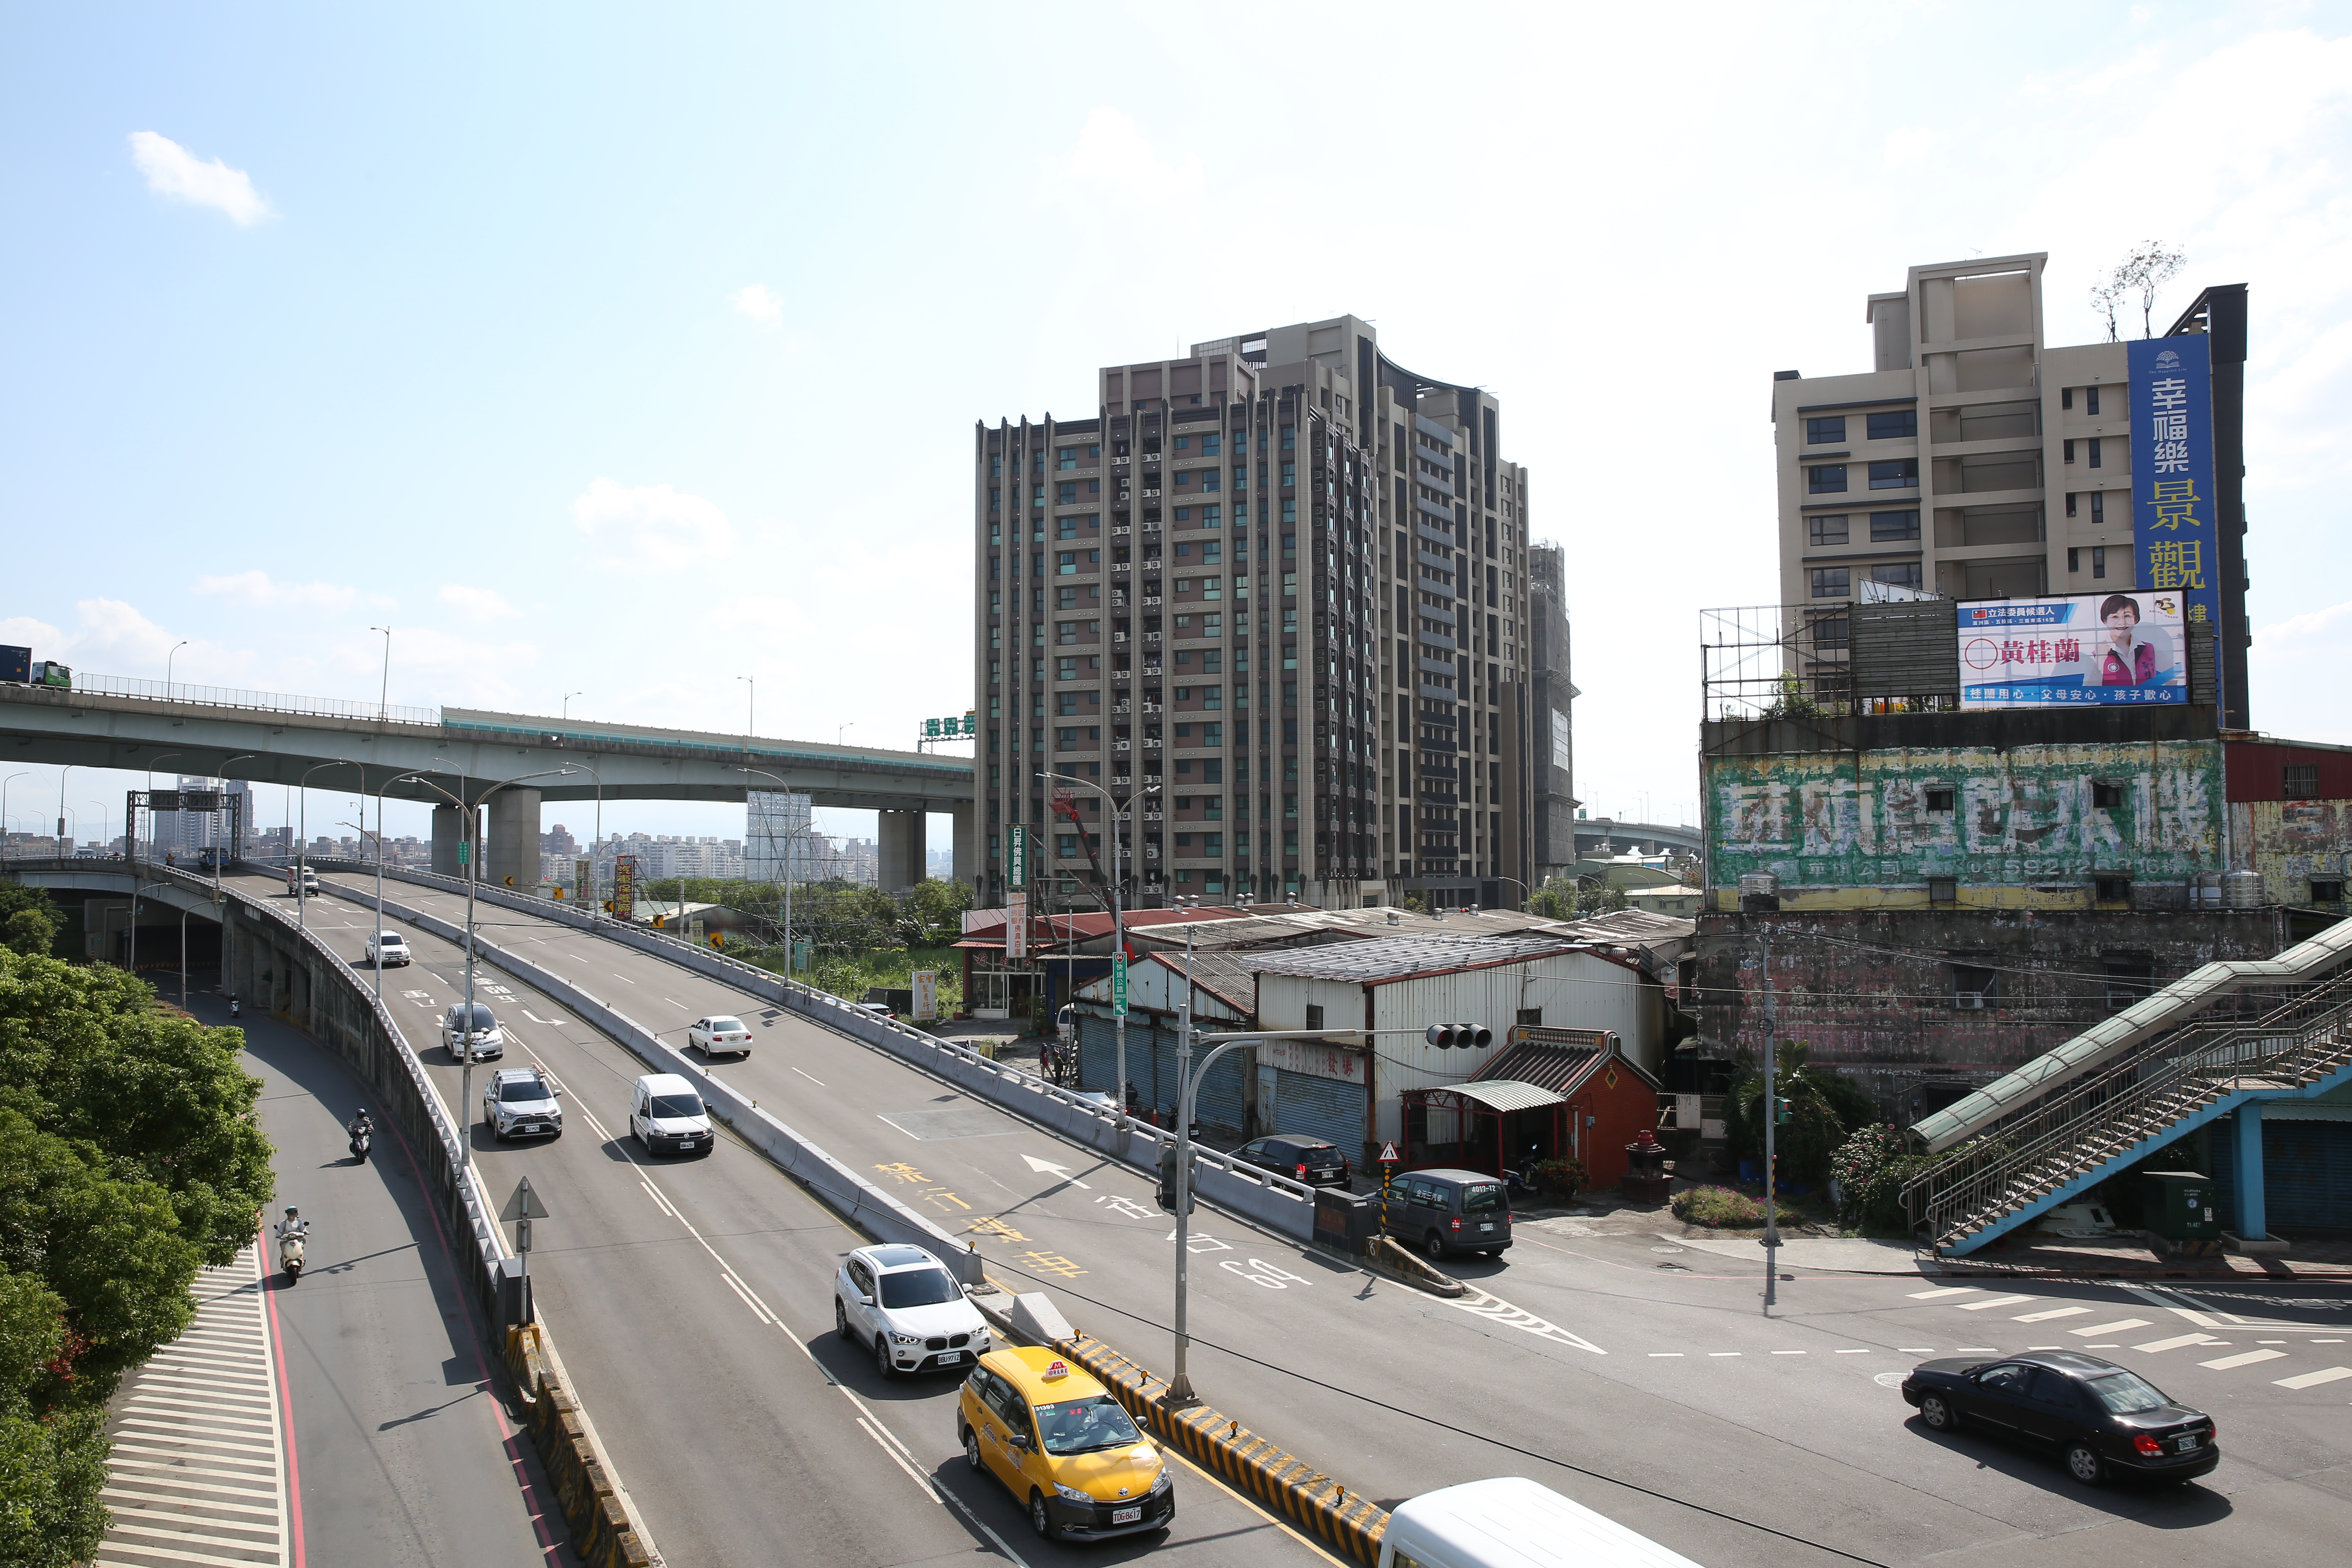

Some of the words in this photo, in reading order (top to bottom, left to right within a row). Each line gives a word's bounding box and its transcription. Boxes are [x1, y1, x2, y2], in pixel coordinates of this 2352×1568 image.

[2152, 378, 2189, 474] 幸福樂
[1987, 606, 2055, 618] 立法委員候選人
[1999, 638, 2080, 665] 黃桂蘭
[1013, 828, 1022, 885] 日昇佛具總匯
[1416, 1189, 1443, 1202] 金元三汽車
[938, 1354, 960, 1363] BBU-9712
[1114, 1508, 1141, 1523] TDG-8617
